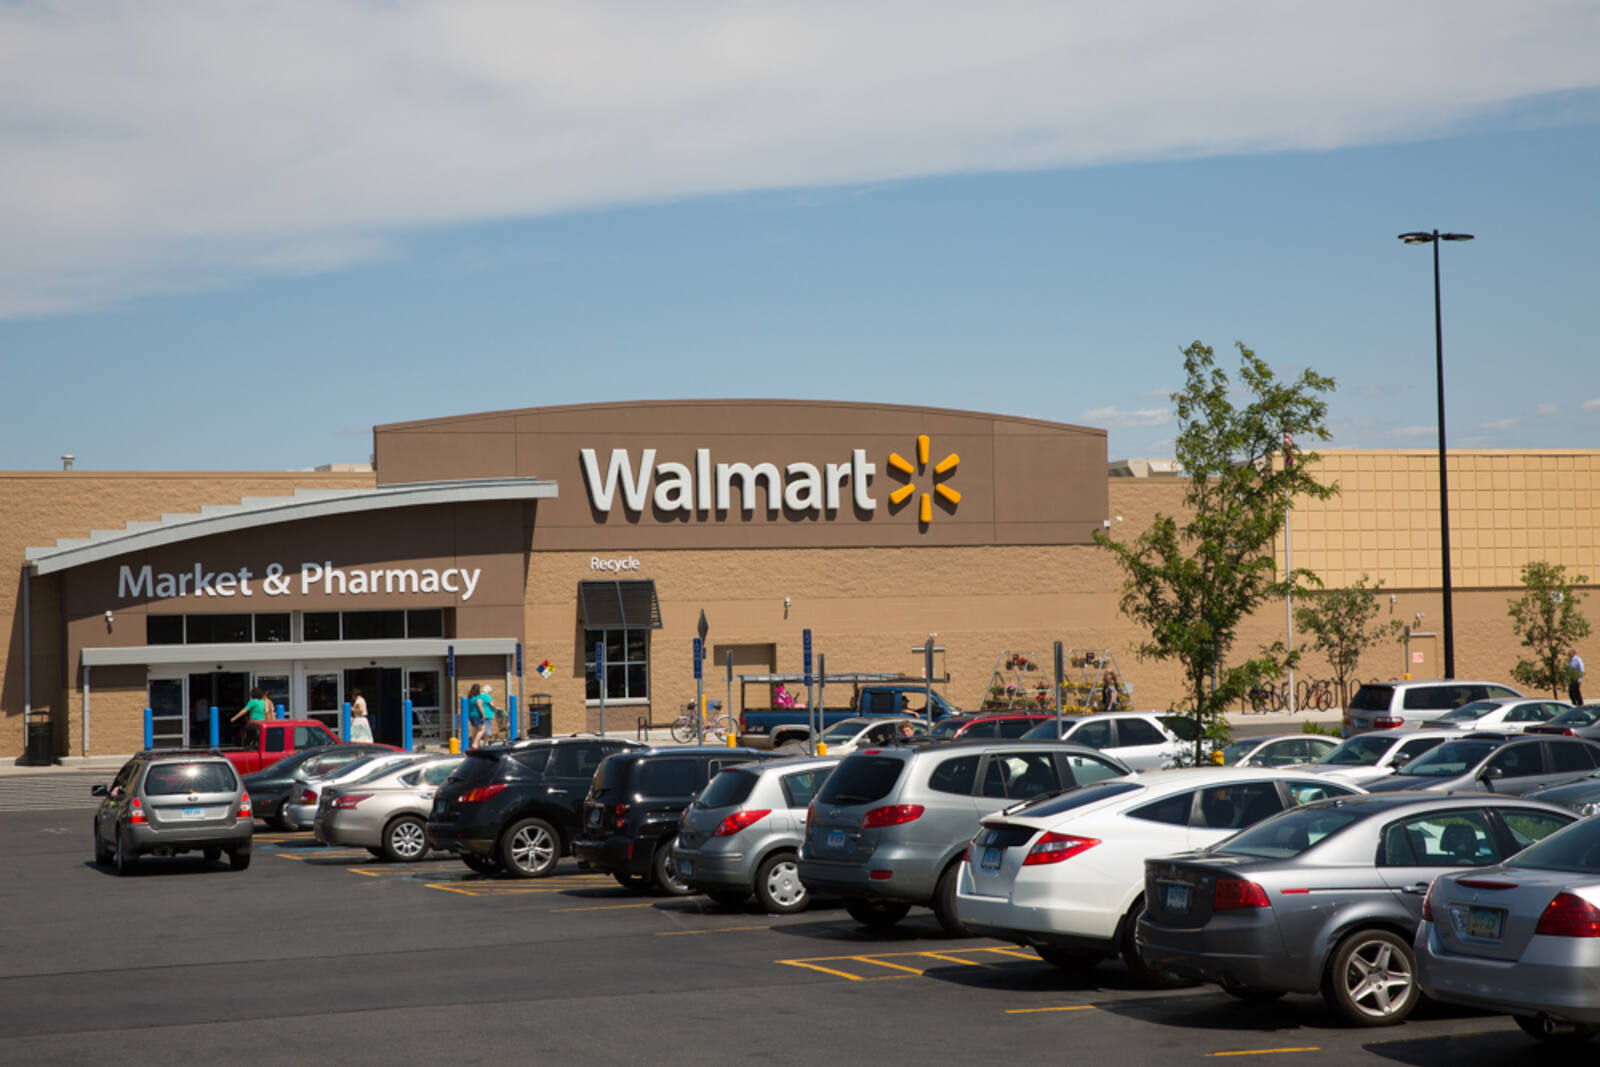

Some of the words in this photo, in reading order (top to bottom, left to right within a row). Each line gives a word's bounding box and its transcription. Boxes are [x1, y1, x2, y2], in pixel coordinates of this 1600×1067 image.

[580, 448, 877, 512] Walmart
[118, 562, 253, 598] Market
[262, 563, 291, 596] &
[301, 561, 481, 600] Pharmacy
[591, 555, 640, 573] Recycle
